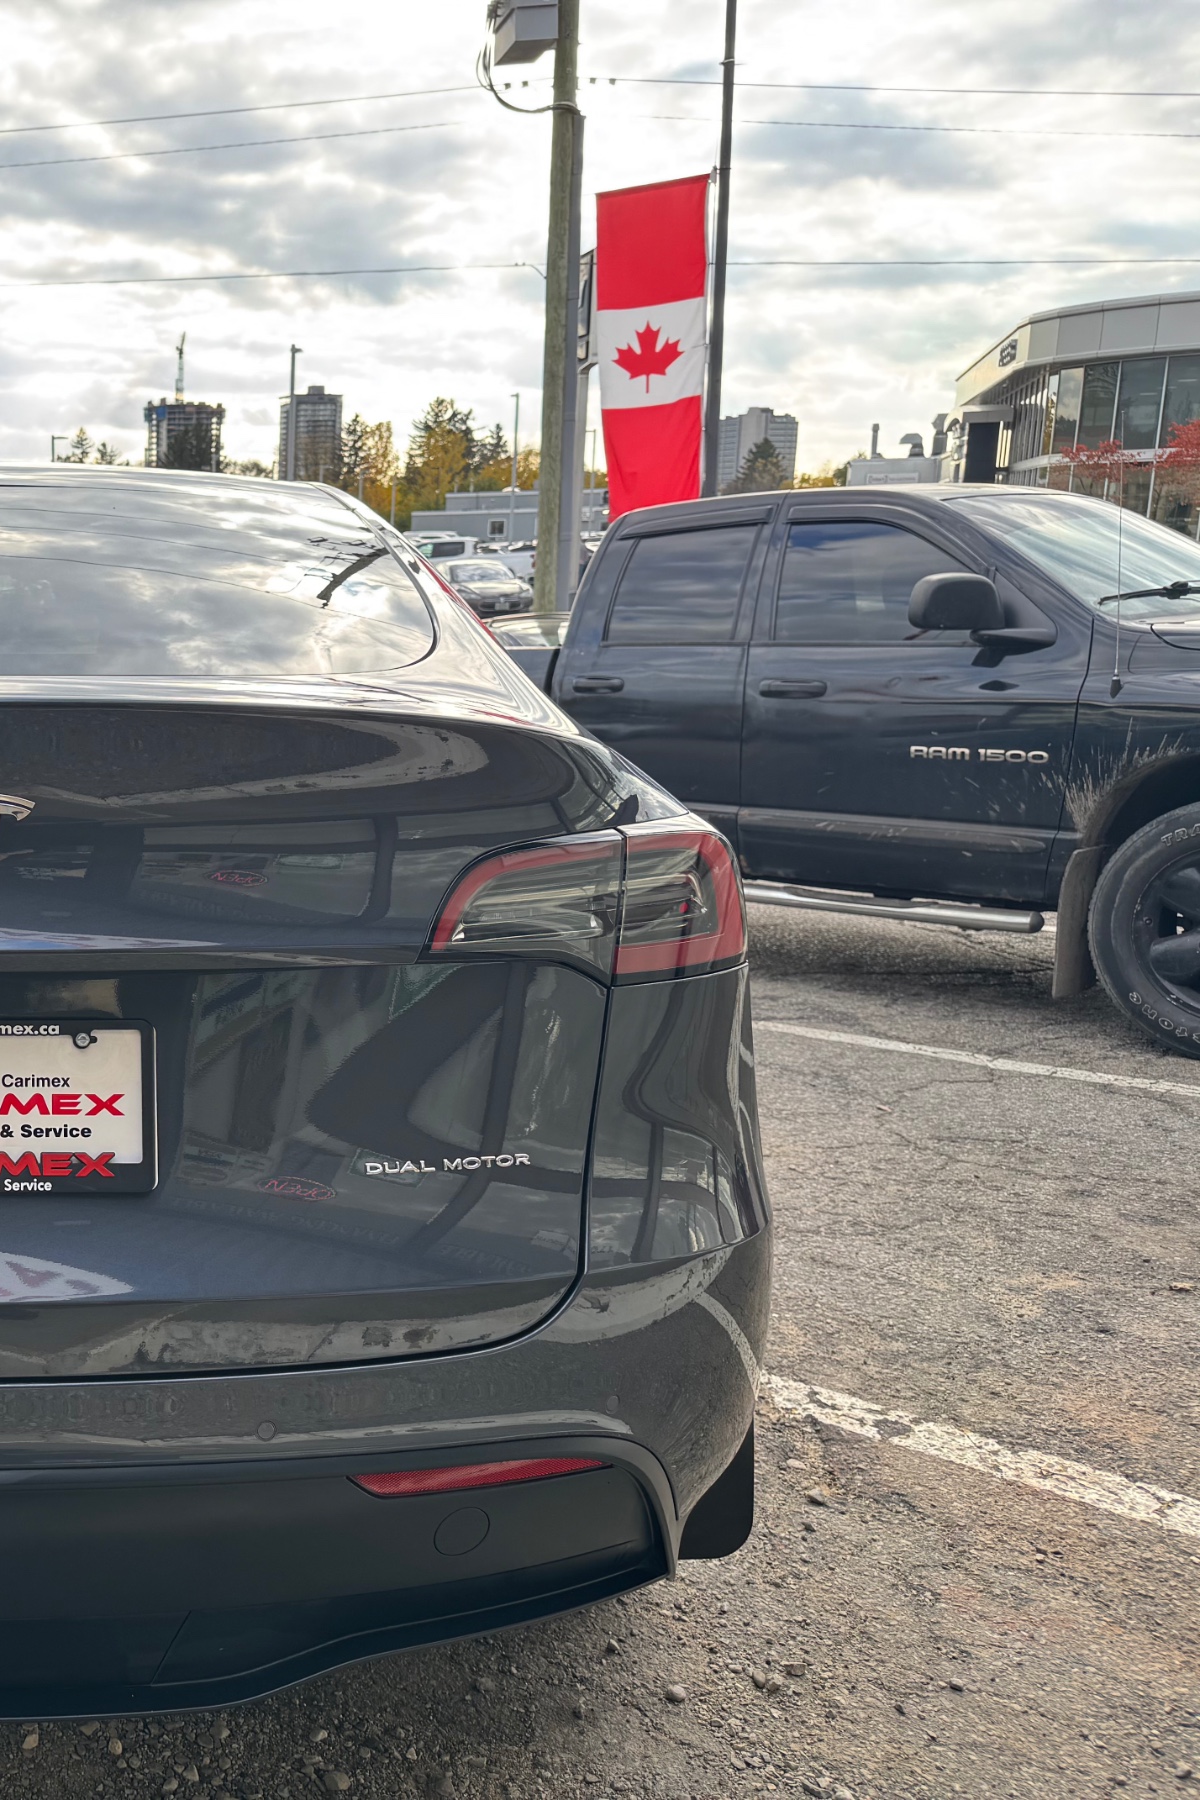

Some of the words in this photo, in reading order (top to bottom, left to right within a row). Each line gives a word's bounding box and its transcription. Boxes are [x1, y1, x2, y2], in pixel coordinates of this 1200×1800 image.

[909, 745, 971, 761] RAM
[977, 748, 1050, 764] 1500
[0, 1074, 71, 1089] Carimex
[0, 1124, 15, 1139] &
[20, 1124, 93, 1139] Service
[364, 1160, 436, 1175] DUAL
[442, 1153, 531, 1171] MOTOR
[3, 1178, 53, 1193] Service
